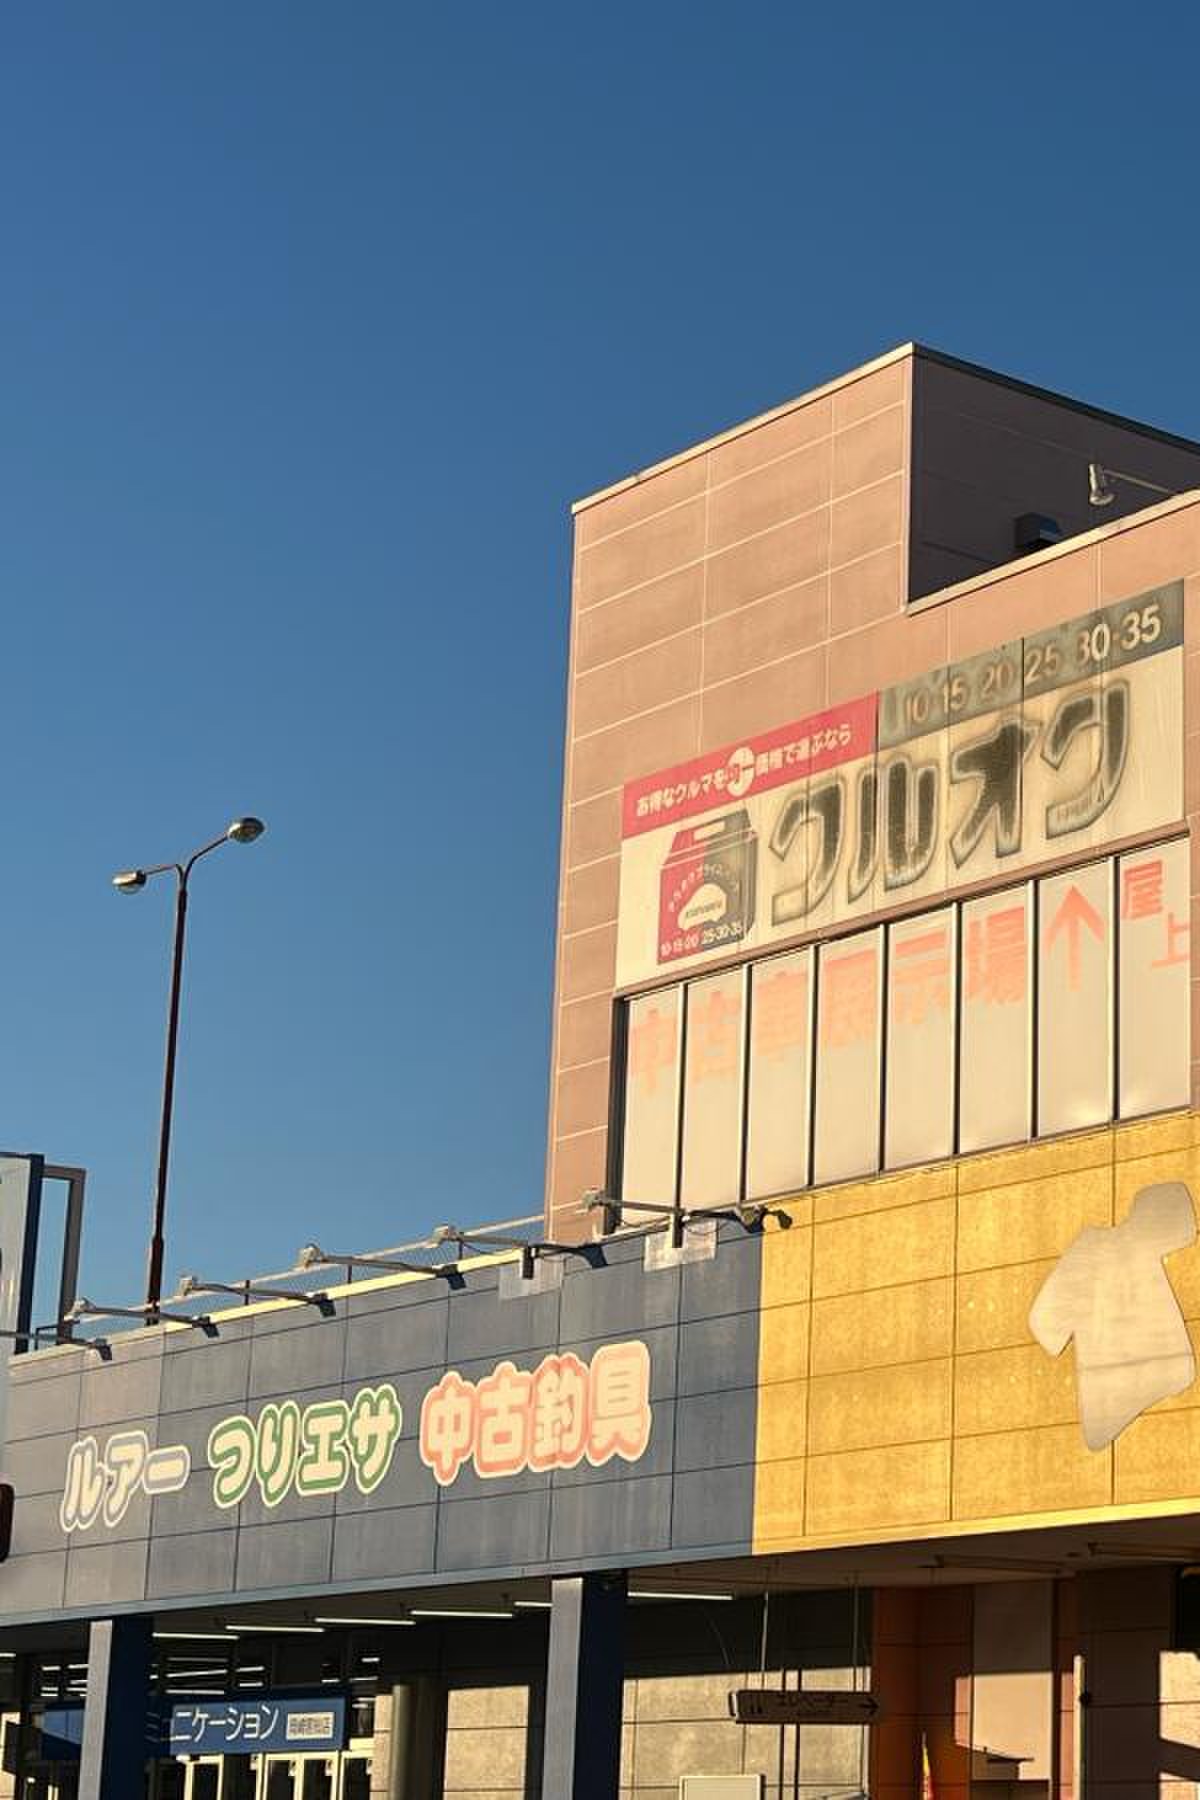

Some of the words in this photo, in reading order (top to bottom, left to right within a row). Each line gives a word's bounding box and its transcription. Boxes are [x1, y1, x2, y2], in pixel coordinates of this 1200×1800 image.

[1026, 642, 1061, 684] 25
[1077, 622, 1111, 667] 30
[1121, 604, 1161, 651] 35
[62, 1431, 191, 1532] ルアー
[420, 1339, 652, 1487] 中古釣具
